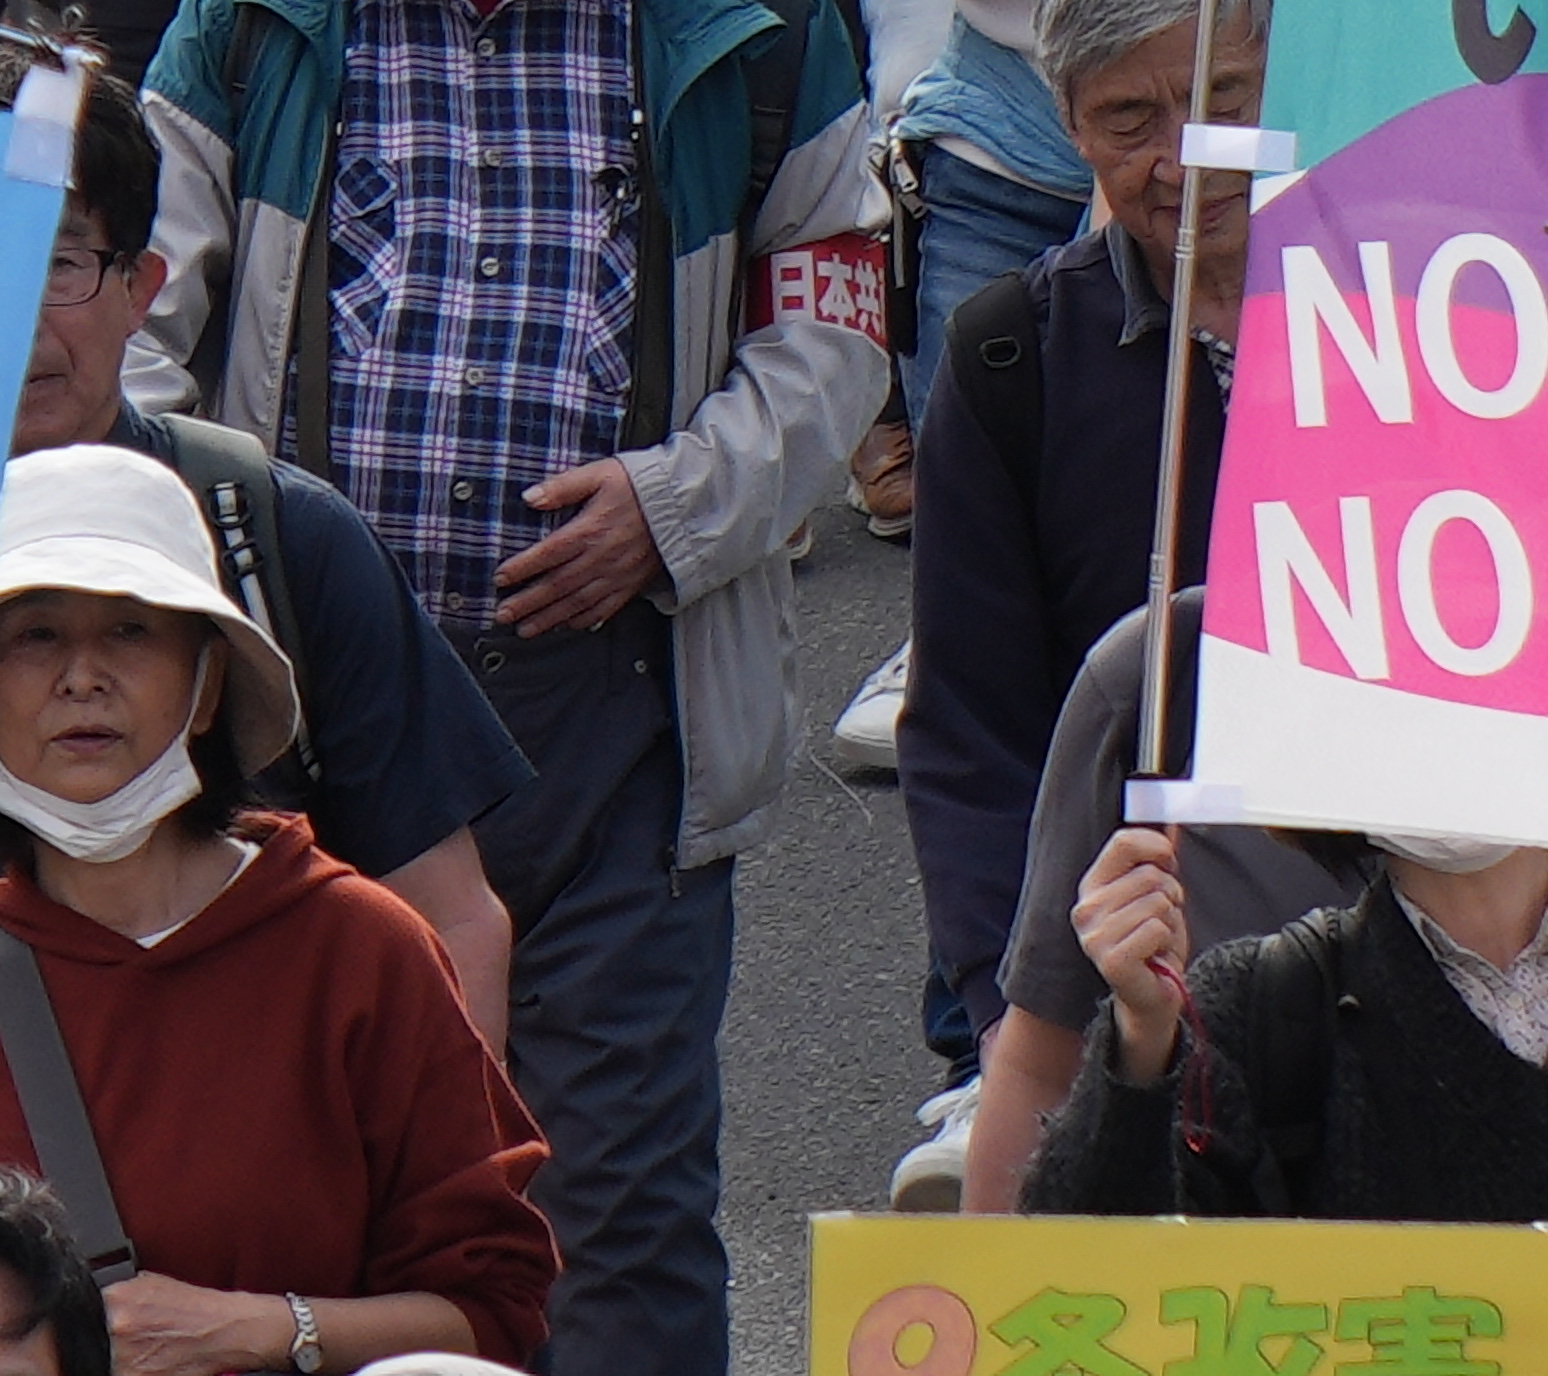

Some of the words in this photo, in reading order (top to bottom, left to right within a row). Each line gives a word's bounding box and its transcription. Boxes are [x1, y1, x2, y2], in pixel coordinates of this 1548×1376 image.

[769, 249, 888, 340] 日本共
[1252, 487, 1537, 682] NO
